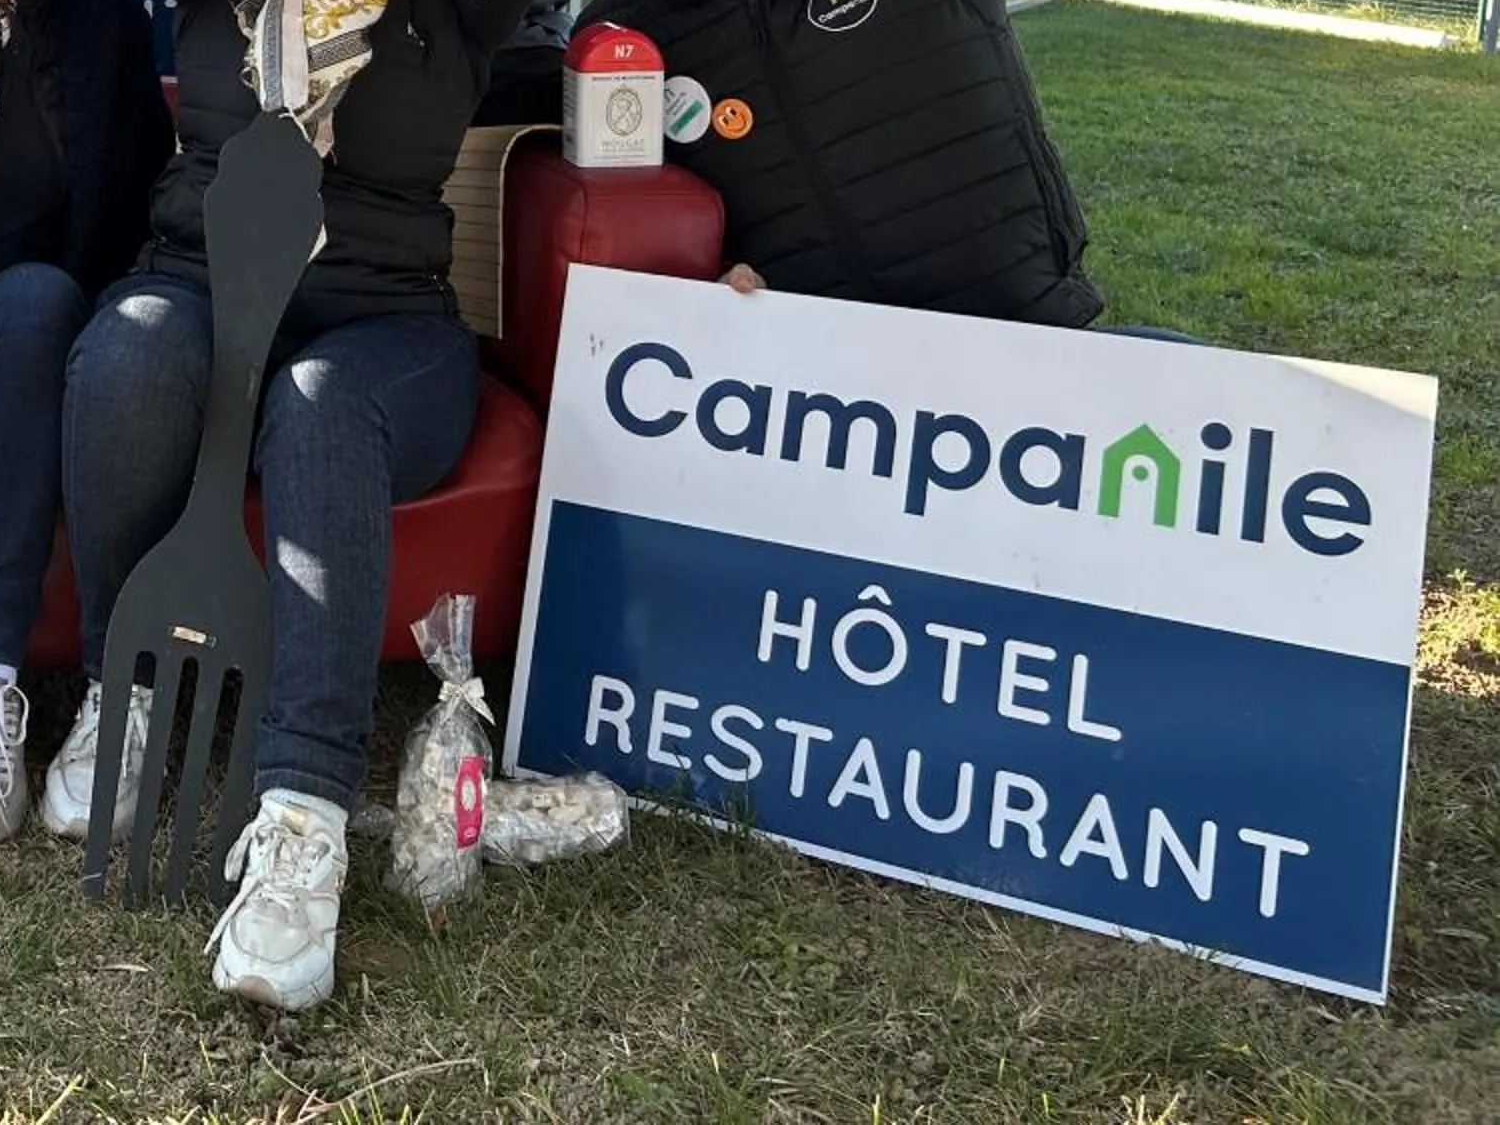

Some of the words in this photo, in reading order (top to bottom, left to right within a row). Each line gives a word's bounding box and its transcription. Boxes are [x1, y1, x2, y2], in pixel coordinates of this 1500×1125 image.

[615, 44, 634, 59] N7
[605, 342, 1373, 557] Campanile
[756, 583, 1123, 743] HÔTEL
[583, 674, 1310, 918] RESTAURANT
